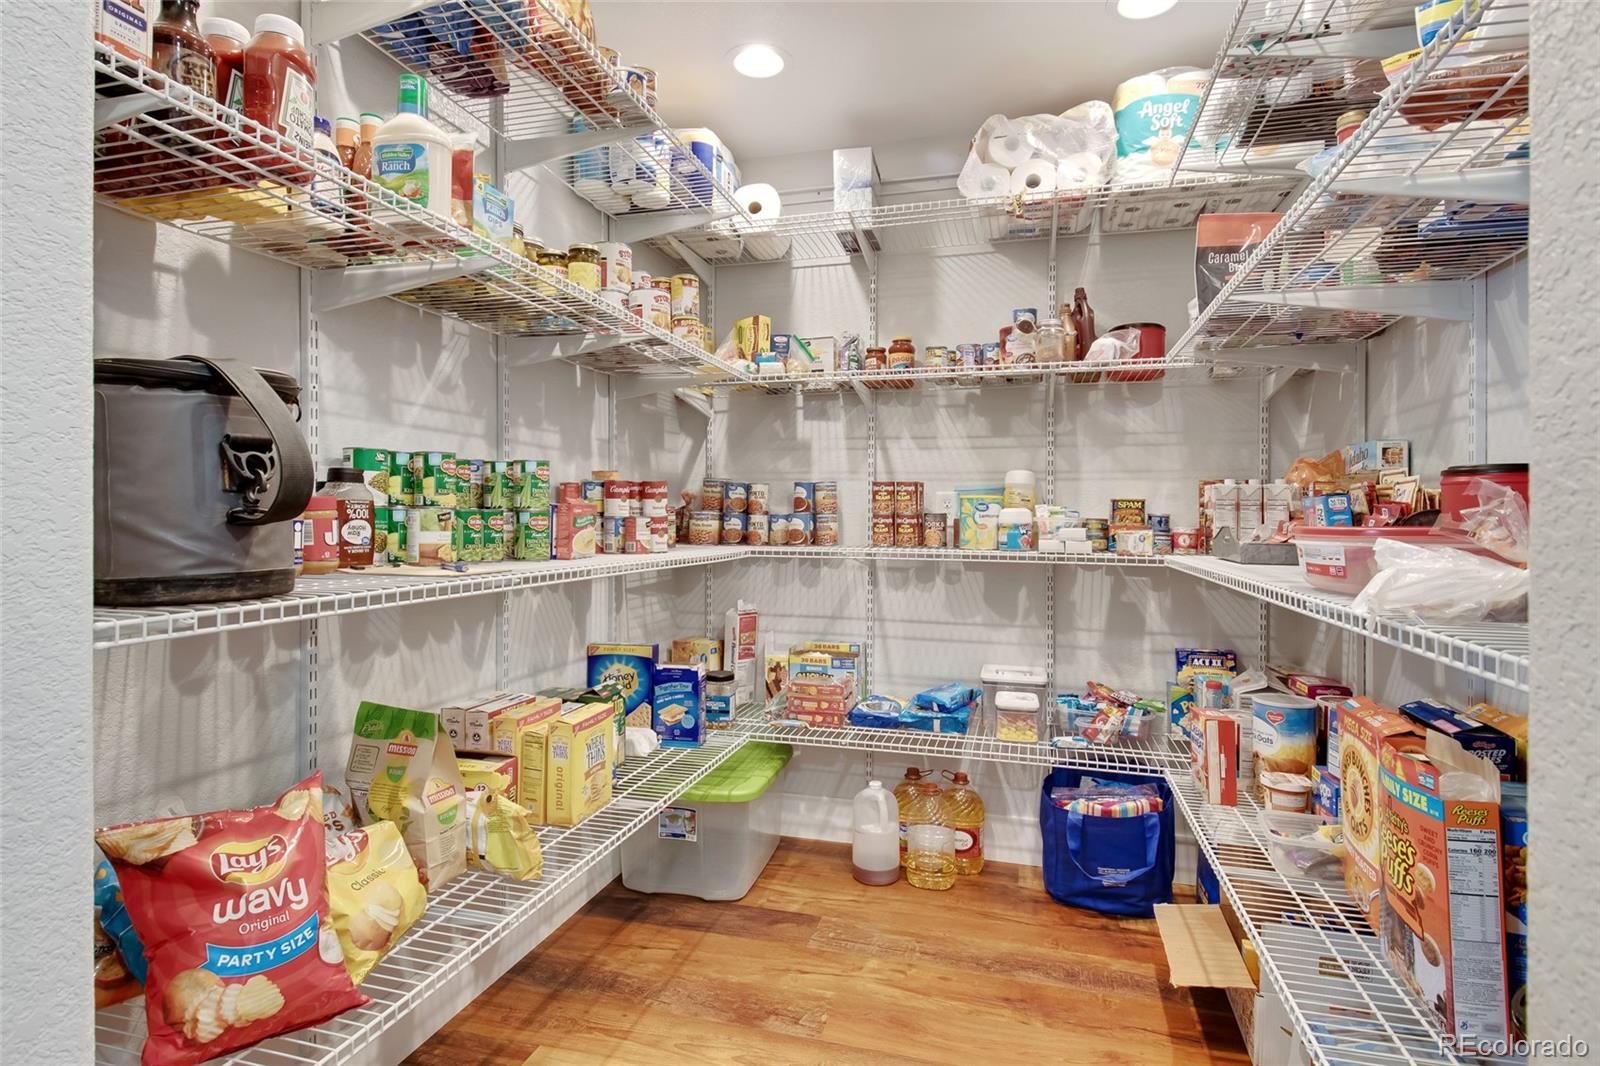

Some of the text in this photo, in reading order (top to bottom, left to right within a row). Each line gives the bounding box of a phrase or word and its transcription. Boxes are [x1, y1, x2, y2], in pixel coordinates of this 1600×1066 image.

[108, 5, 143, 27] ORIGINAL
[1136, 98, 1191, 118] Angel
[1150, 113, 1184, 131] Soft
[381, 161, 411, 171] Ranch
[1208, 250, 1249, 264] Caramel
[1193, 658, 1210, 666] ACT
[604, 672, 635, 684] Honey
[554, 767, 564, 810] original
[1402, 787, 1428, 813] SIZE
[1457, 813, 1487, 826] Puffs
[217, 838, 286, 875] Lay's
[350, 867, 386, 891] Classic
[212, 876, 310, 925] wavy
[238, 911, 290, 936] Original
[216, 926, 315, 969] PARTY SIZE
